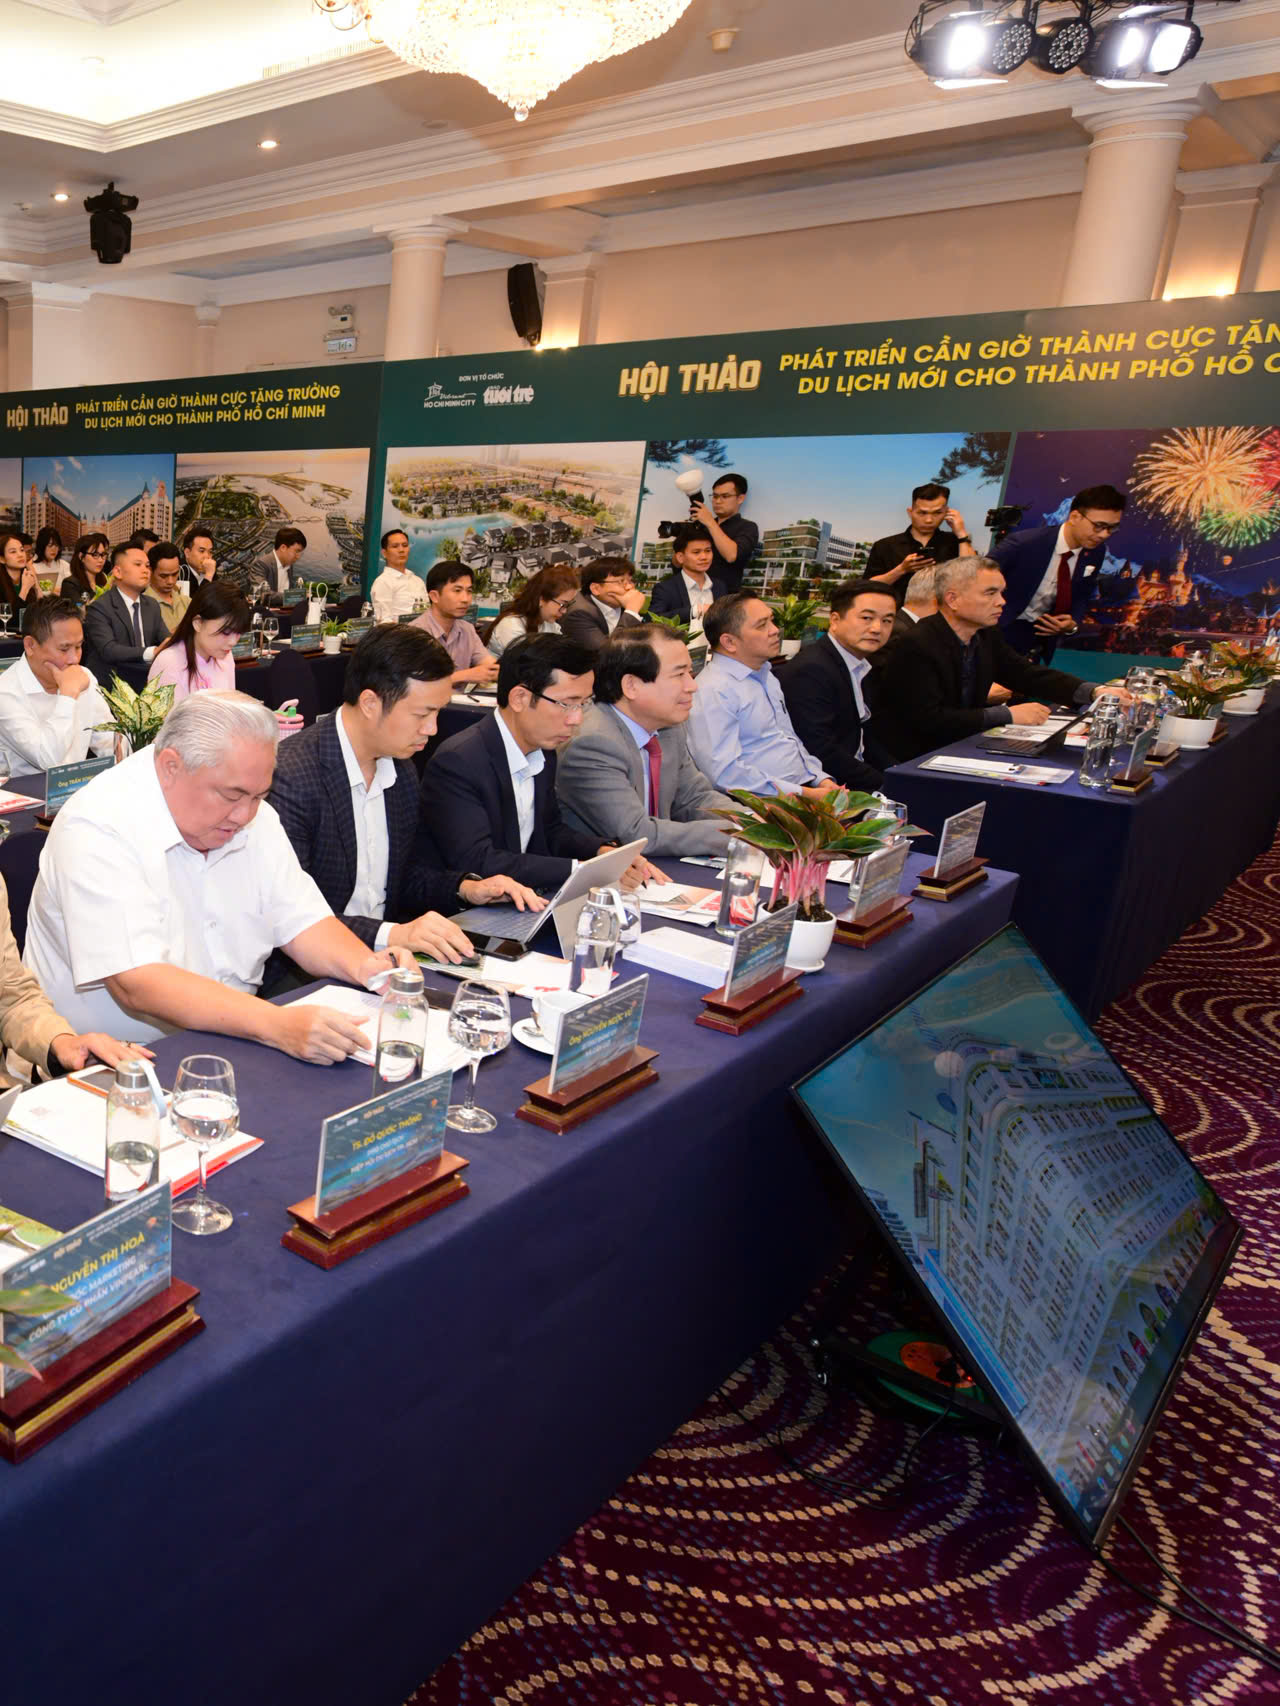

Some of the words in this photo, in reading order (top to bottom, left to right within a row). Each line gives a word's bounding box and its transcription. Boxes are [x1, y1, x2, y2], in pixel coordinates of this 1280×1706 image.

[778, 347, 838, 371] PHÁT
[843, 338, 907, 368] TRIỂN
[913, 335, 971, 363] CẦN
[978, 333, 1033, 360] GIỜ
[1039, 329, 1136, 356] THÀNH
[1145, 325, 1216, 353] CỰC
[618, 360, 669, 402] HỘI
[678, 354, 762, 394] THẢO
[798, 376, 830, 394] DU
[835, 372, 890, 397] LỊCH
[897, 365, 948, 389] MỚI
[954, 365, 1017, 388] CHO
[1025, 358, 1120, 384] THÀNH
[1128, 348, 1199, 379] PHỐ
[1203, 344, 1254, 376] HỒ
[75, 400, 100, 414] PHÁT
[102, 394, 128, 413] TRIỂN
[131, 393, 154, 412] CẦN
[156, 395, 178, 410] GIỜ
[181, 391, 218, 407] THÀNH
[220, 391, 248, 407] CỰC
[250, 386, 284, 403] TĂNG
[287, 382, 341, 401] TRƯỞNG
[6, 405, 29, 432] HỘI
[32, 402, 69, 427] THẢO
[84, 417, 99, 429] DU
[101, 415, 122, 431] LỊCH
[125, 412, 146, 428] MỚI
[148, 413, 173, 426] CHO
[176, 409, 213, 425] THÀNH
[216, 404, 241, 423] PHỐ
[244, 401, 262, 421] HỒ
[265, 403, 289, 420] CHÍ
[292, 404, 326, 419] MINH
[100, 1247, 118, 1266] THỊ
